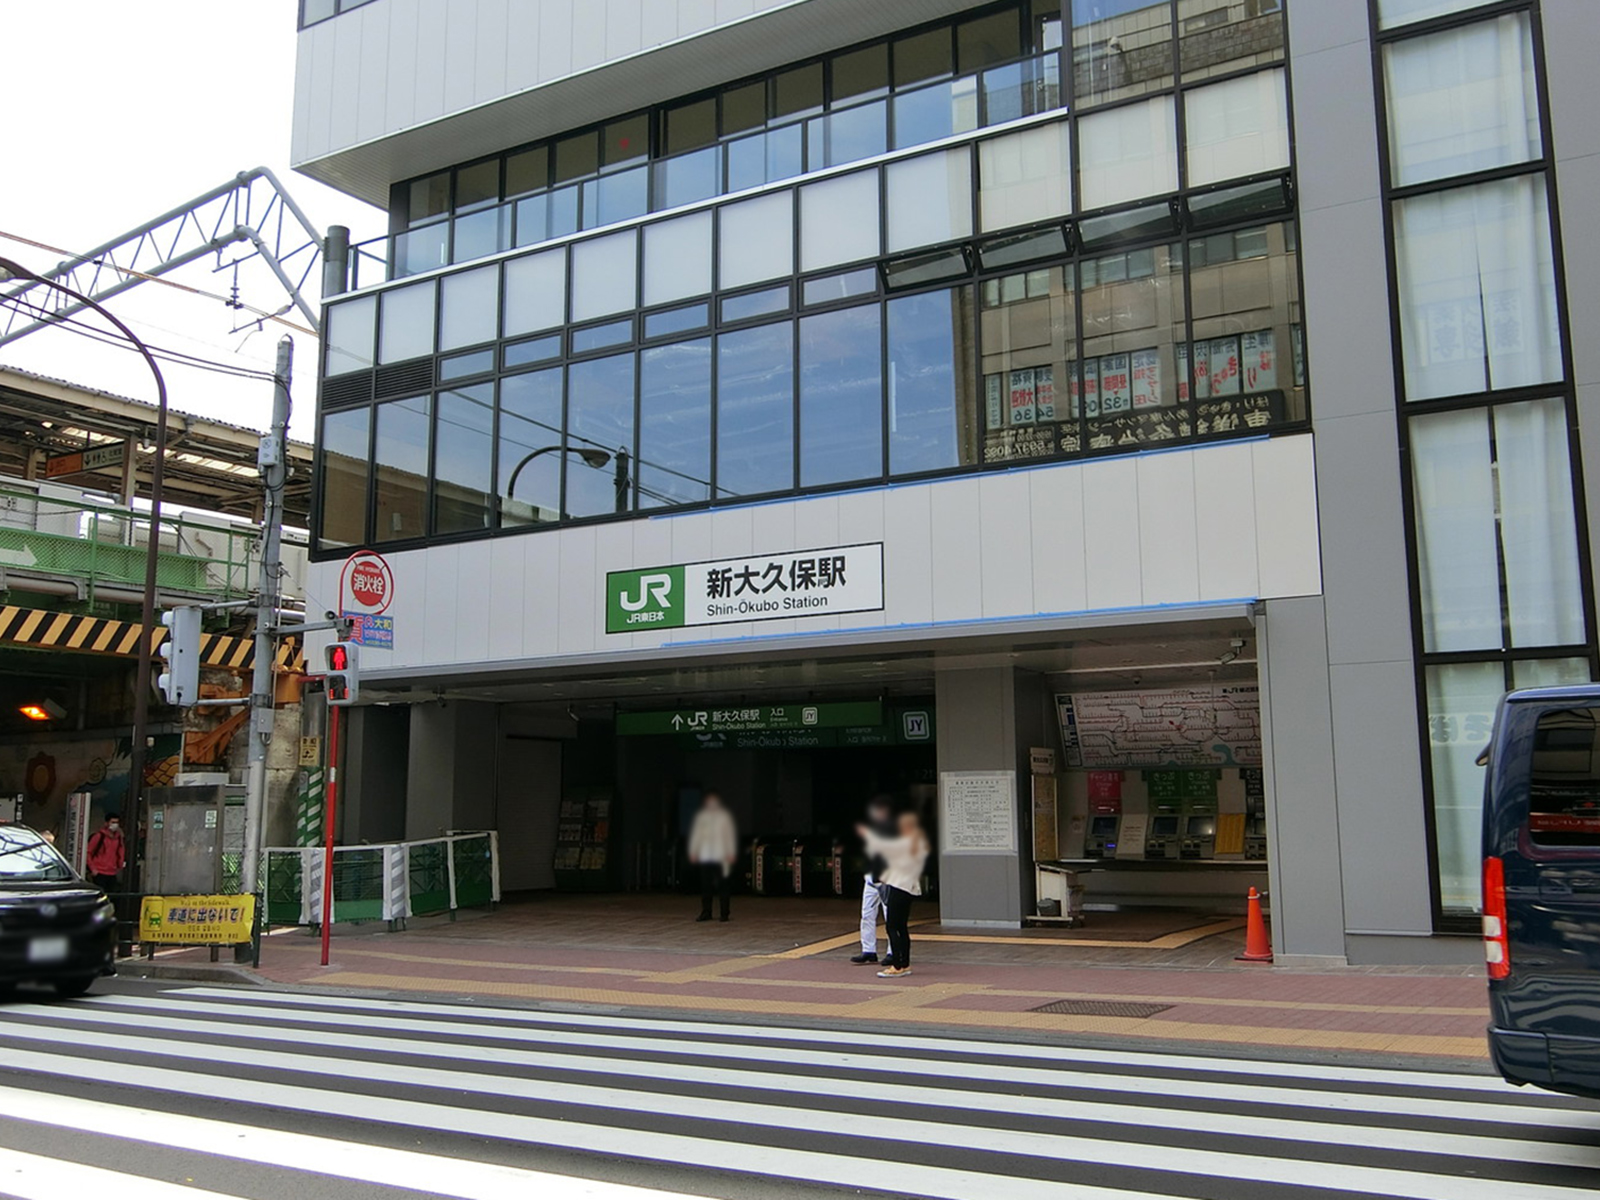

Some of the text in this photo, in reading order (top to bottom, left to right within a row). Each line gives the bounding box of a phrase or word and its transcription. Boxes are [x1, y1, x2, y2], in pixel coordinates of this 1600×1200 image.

[355, 573, 383, 594] 消火栓
[706, 556, 846, 599] 新大久保駅
[620, 573, 672, 612] JR
[783, 594, 829, 611] Station
[626, 610, 666, 625] JR東日本
[687, 710, 709, 727] JR
[712, 708, 761, 723] 新大久保駅
[770, 707, 785, 717] 入口
